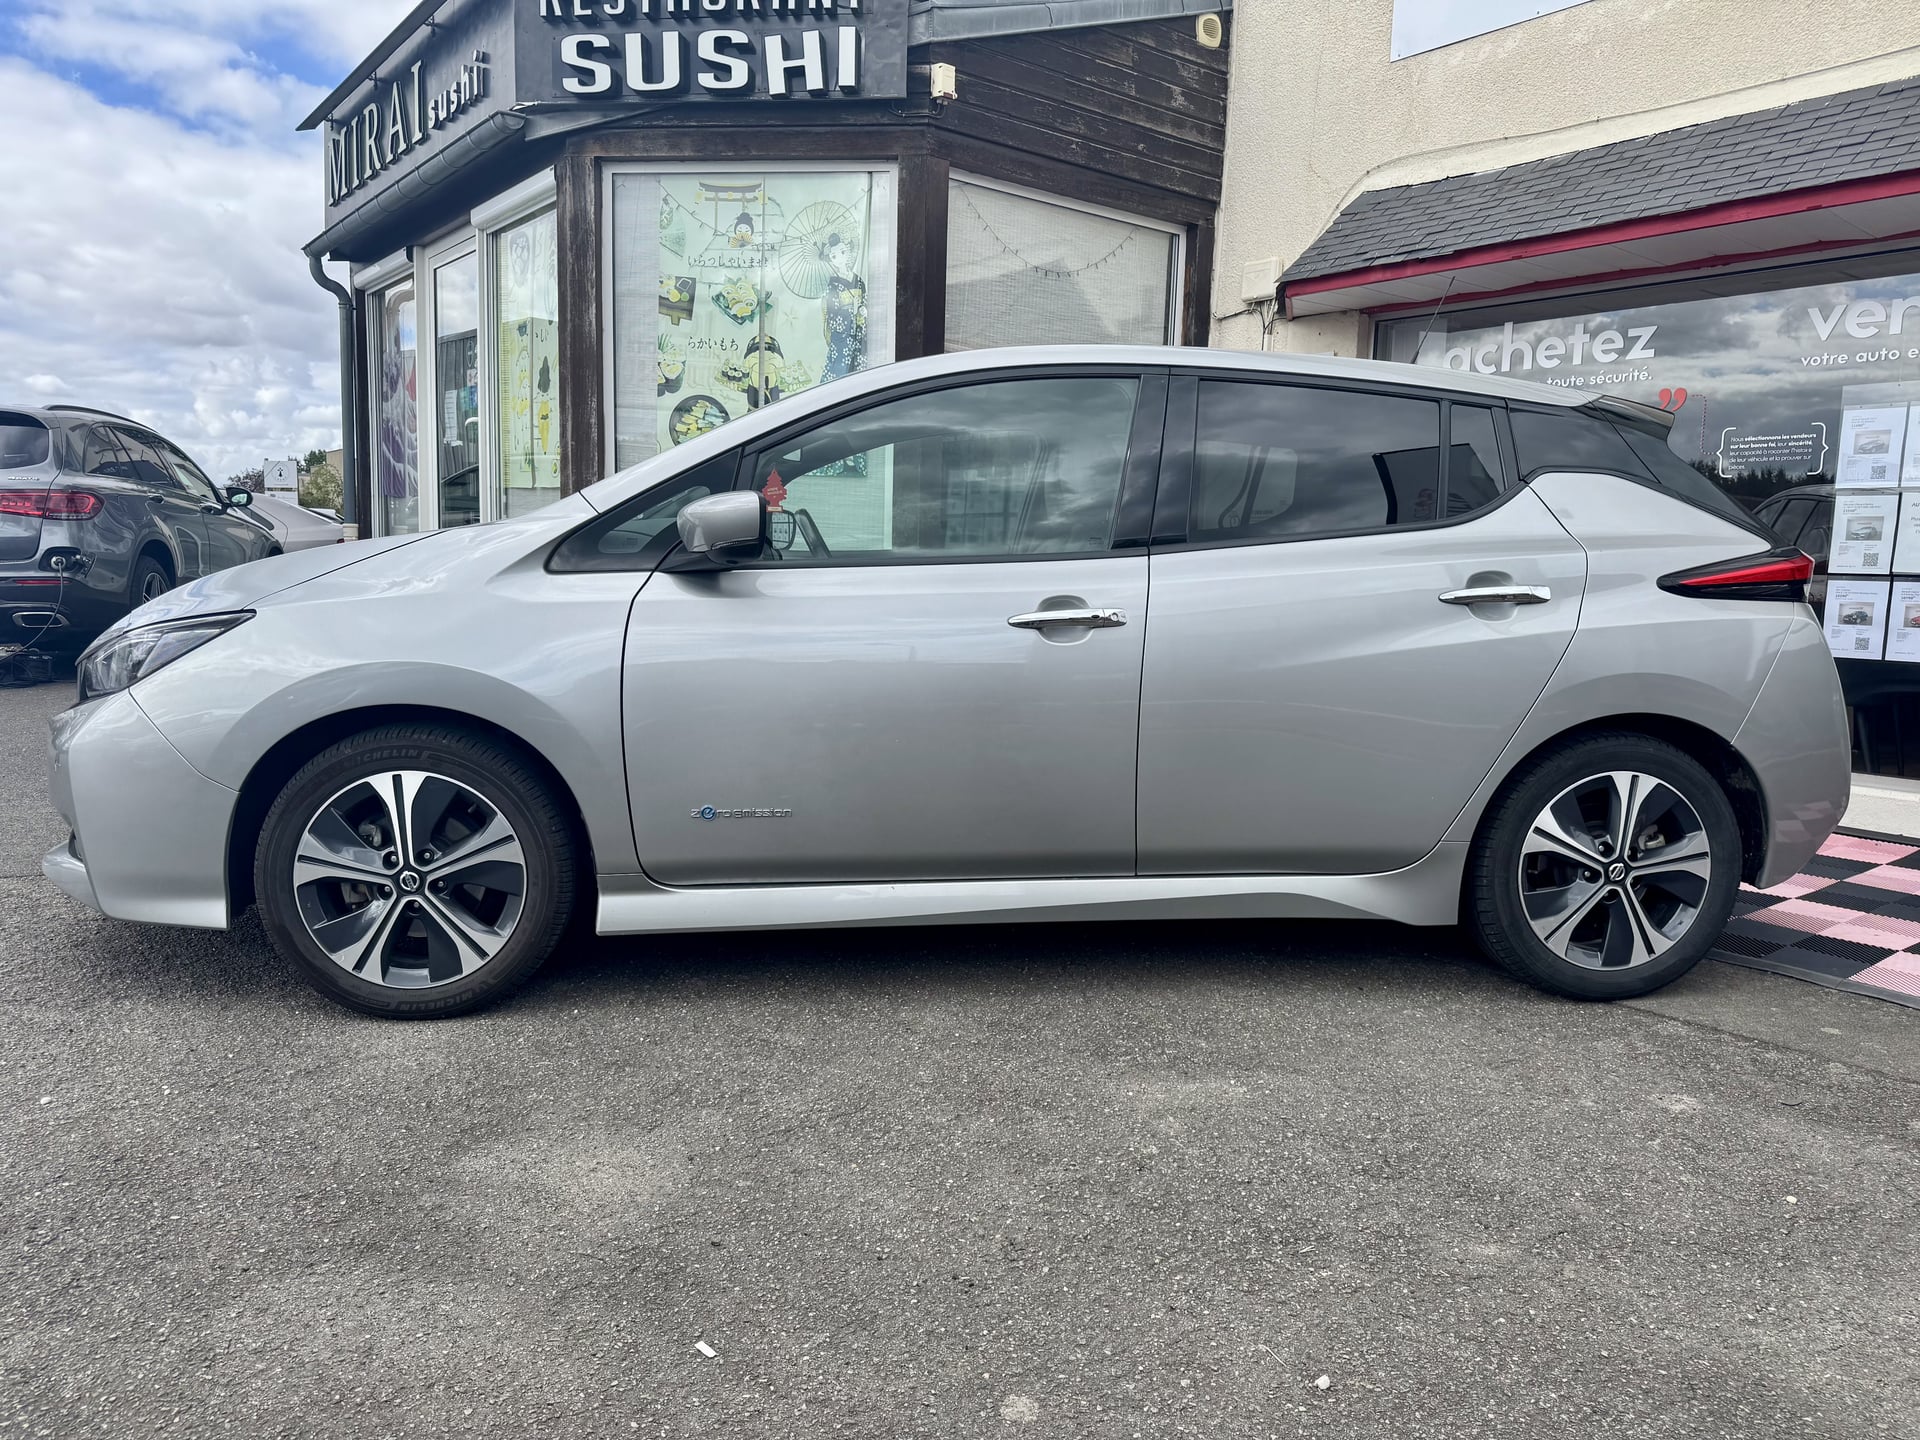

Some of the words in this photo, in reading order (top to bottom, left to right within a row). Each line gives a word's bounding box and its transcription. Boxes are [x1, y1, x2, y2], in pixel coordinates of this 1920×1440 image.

[561, 26, 857, 96] SUSHI
[328, 60, 425, 206] MIRAI
[1443, 322, 1658, 374] achetez
[1801, 352, 1849, 367] votre
[1855, 347, 1900, 362] auto
[1589, 366, 1653, 385] sécurité.
